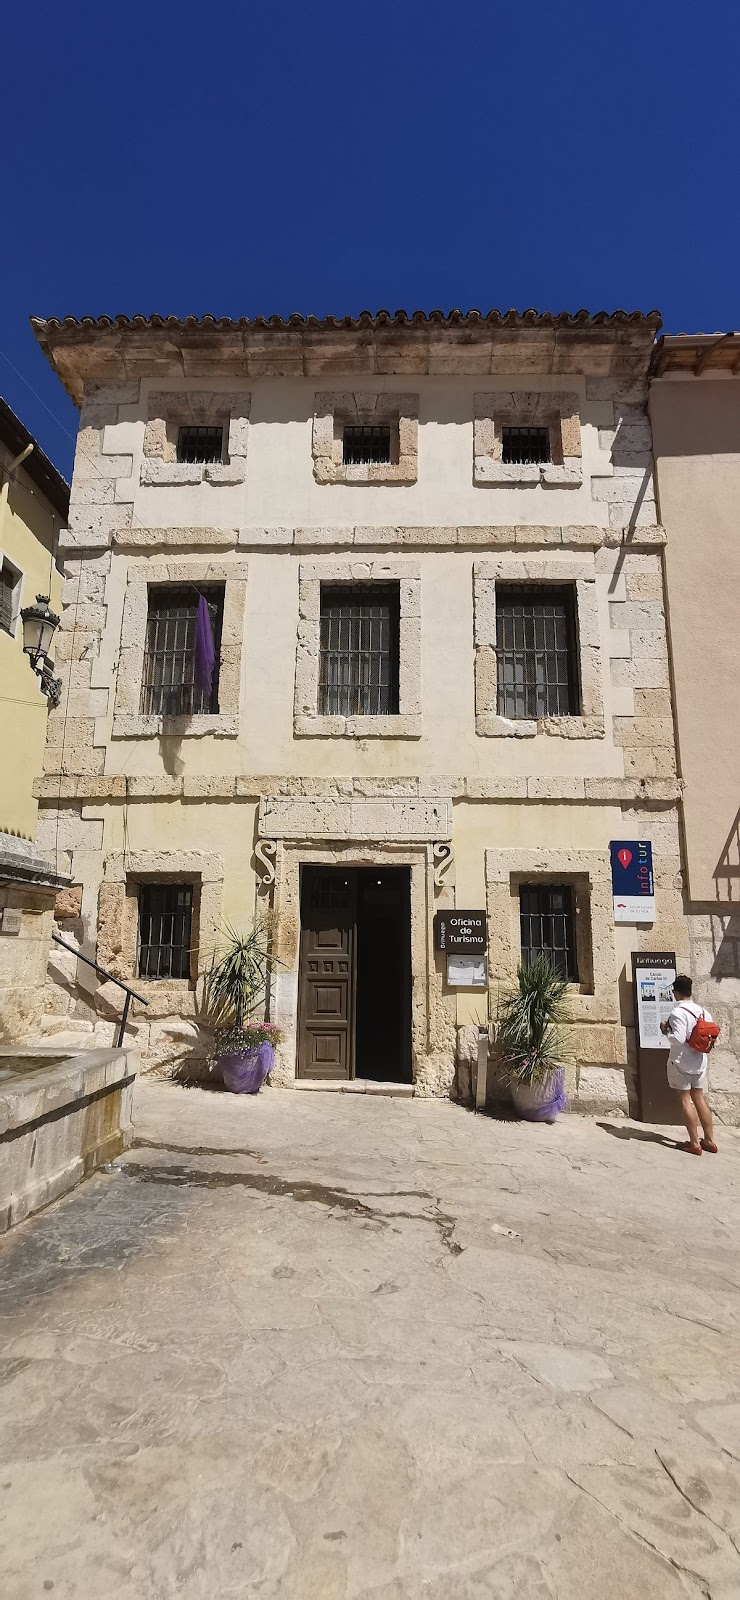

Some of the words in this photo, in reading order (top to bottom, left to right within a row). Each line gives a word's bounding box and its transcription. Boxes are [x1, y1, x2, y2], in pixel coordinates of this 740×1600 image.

[637, 842, 649, 894] infotur
[450, 918, 482, 926] Oficina
[460, 927, 472, 935] de
[449, 935, 484, 943] Turismo
